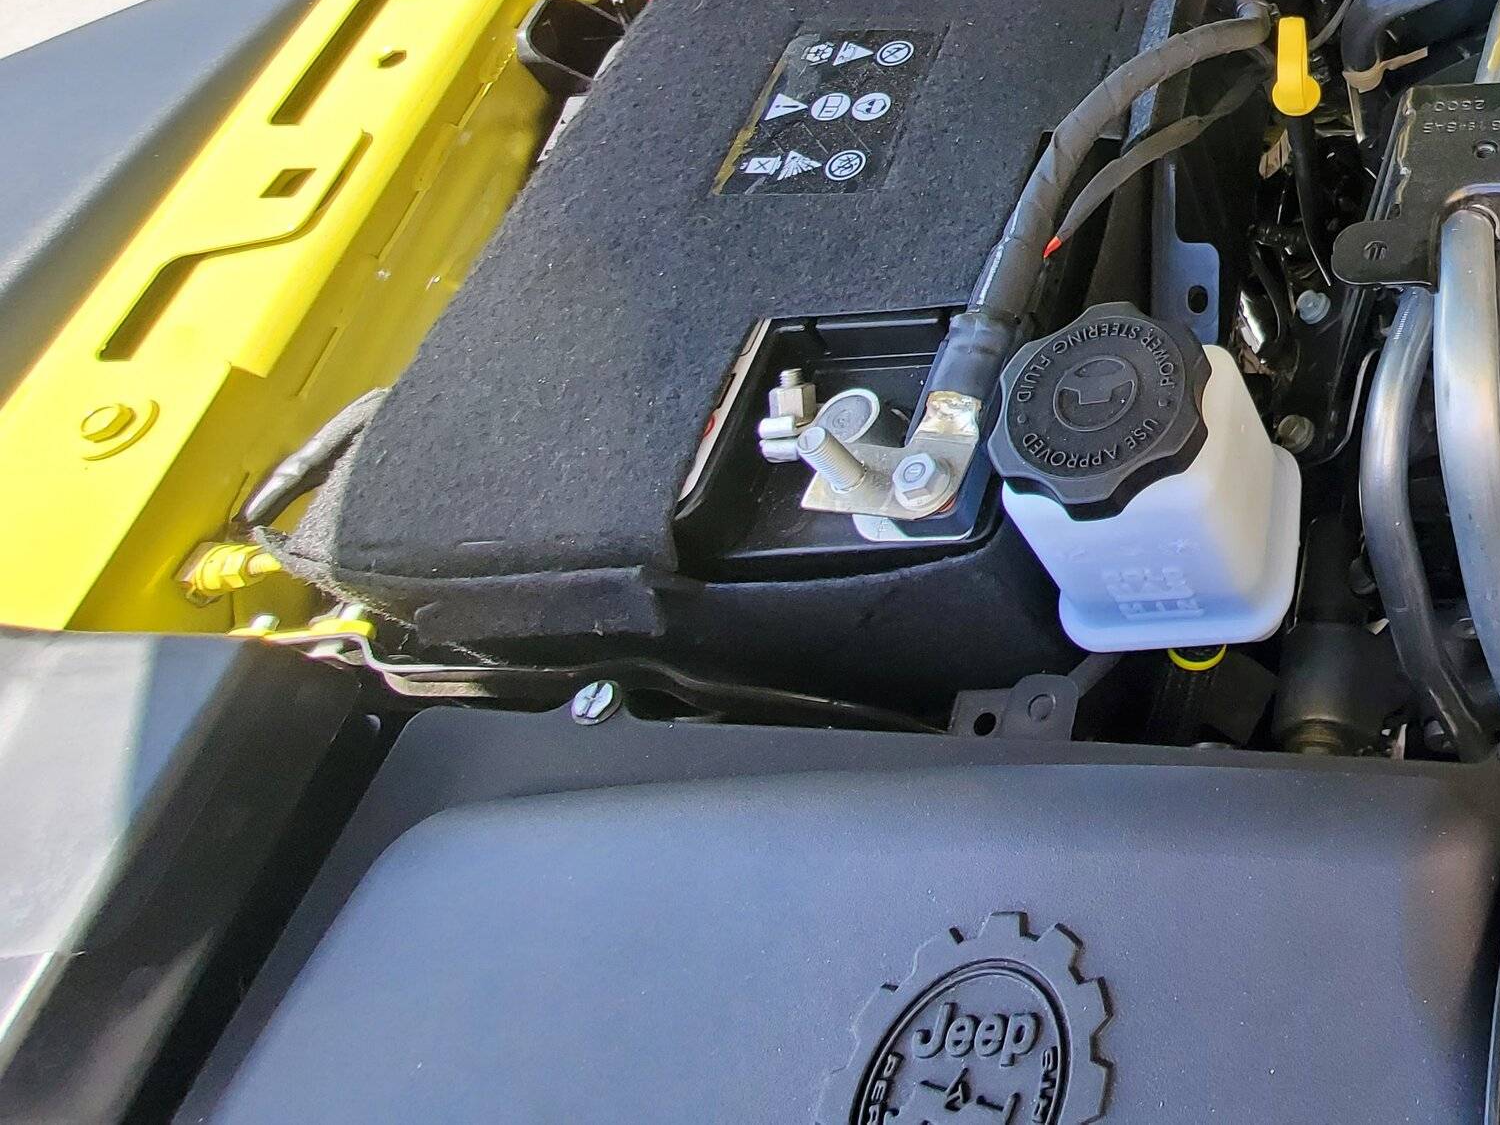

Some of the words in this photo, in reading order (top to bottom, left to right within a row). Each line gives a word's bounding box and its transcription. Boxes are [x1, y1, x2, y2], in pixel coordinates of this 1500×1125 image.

[1053, 322, 1140, 354] STEERING
[1016, 355, 1051, 402] FLUID
[1140, 331, 1176, 388] POWER
[1023, 433, 1119, 469] APPROVED
[1124, 418, 1159, 450] USE
[911, 1002, 1042, 1067] Jeep
